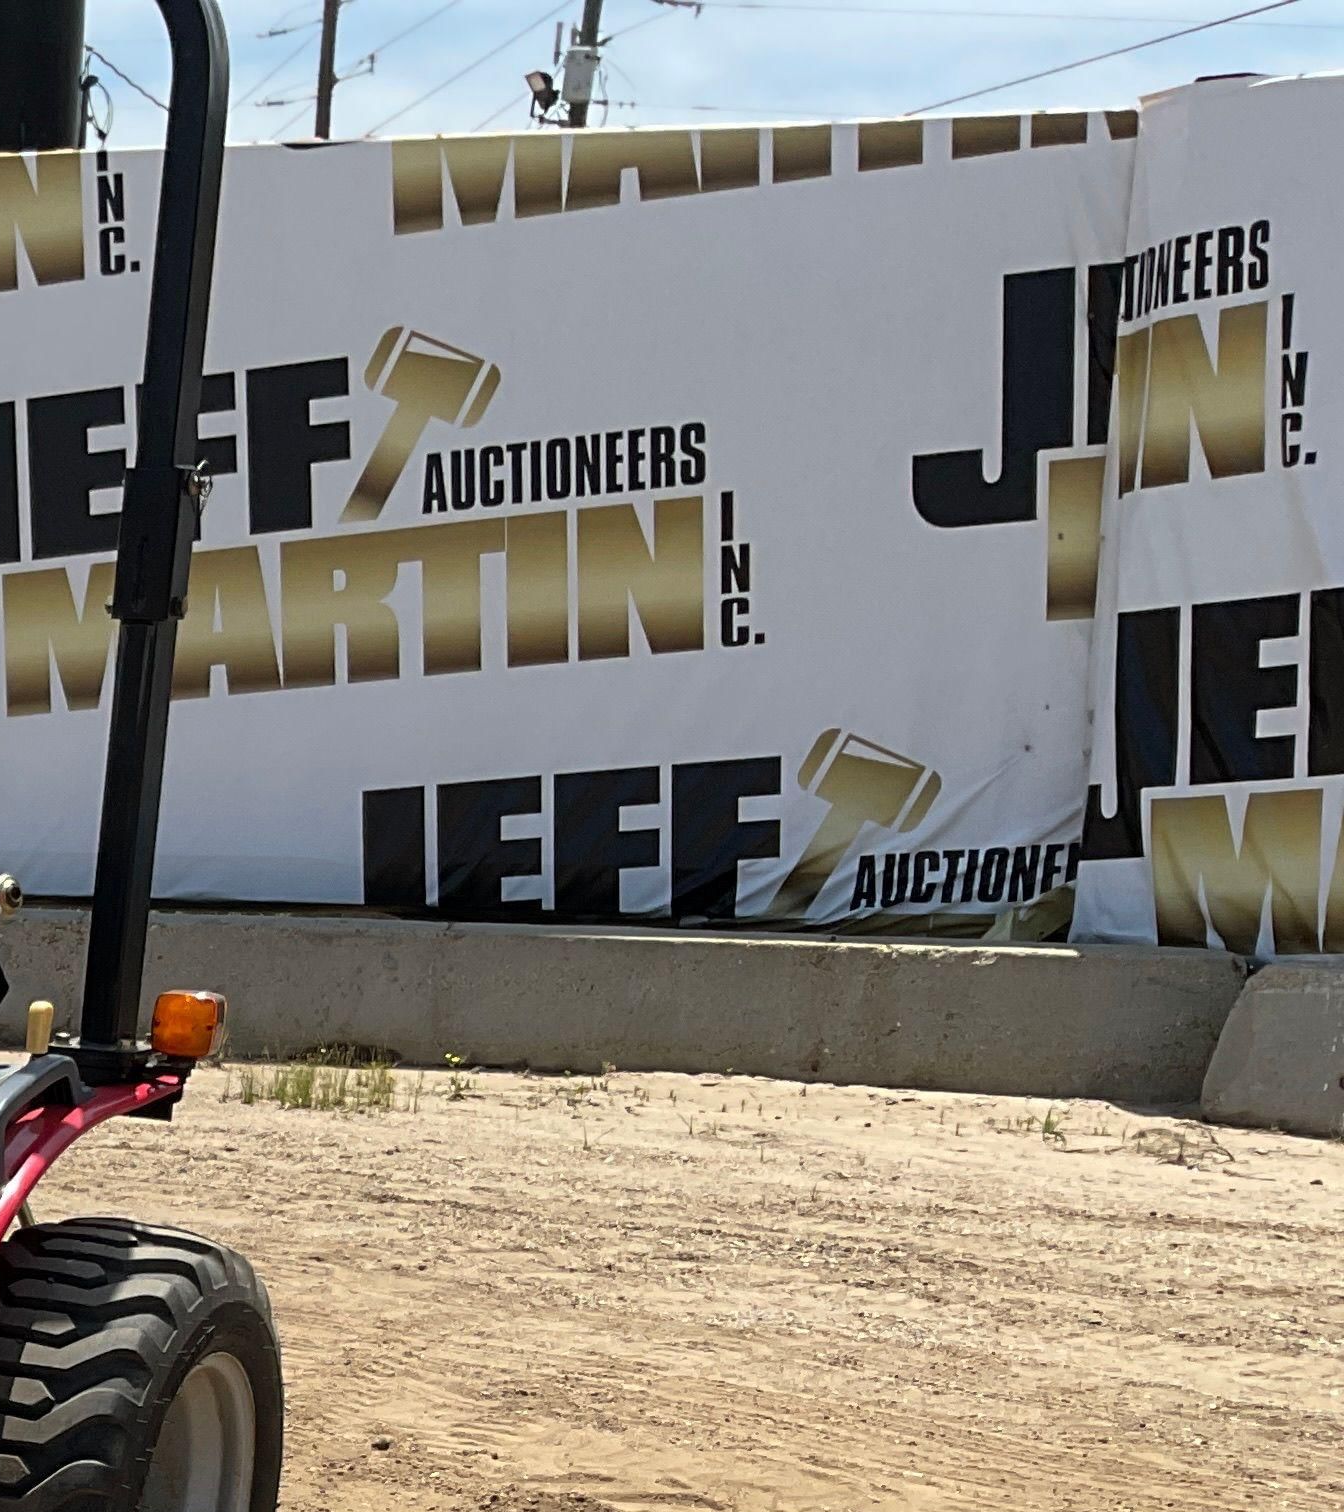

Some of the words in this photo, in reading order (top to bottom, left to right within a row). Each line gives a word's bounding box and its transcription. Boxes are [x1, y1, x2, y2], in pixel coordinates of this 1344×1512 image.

[1281, 293, 1317, 469] INC.
[421, 422, 707, 515] AUCTIONEERS
[2, 495, 705, 717] MARTIN
[720, 490, 766, 648] INC.
